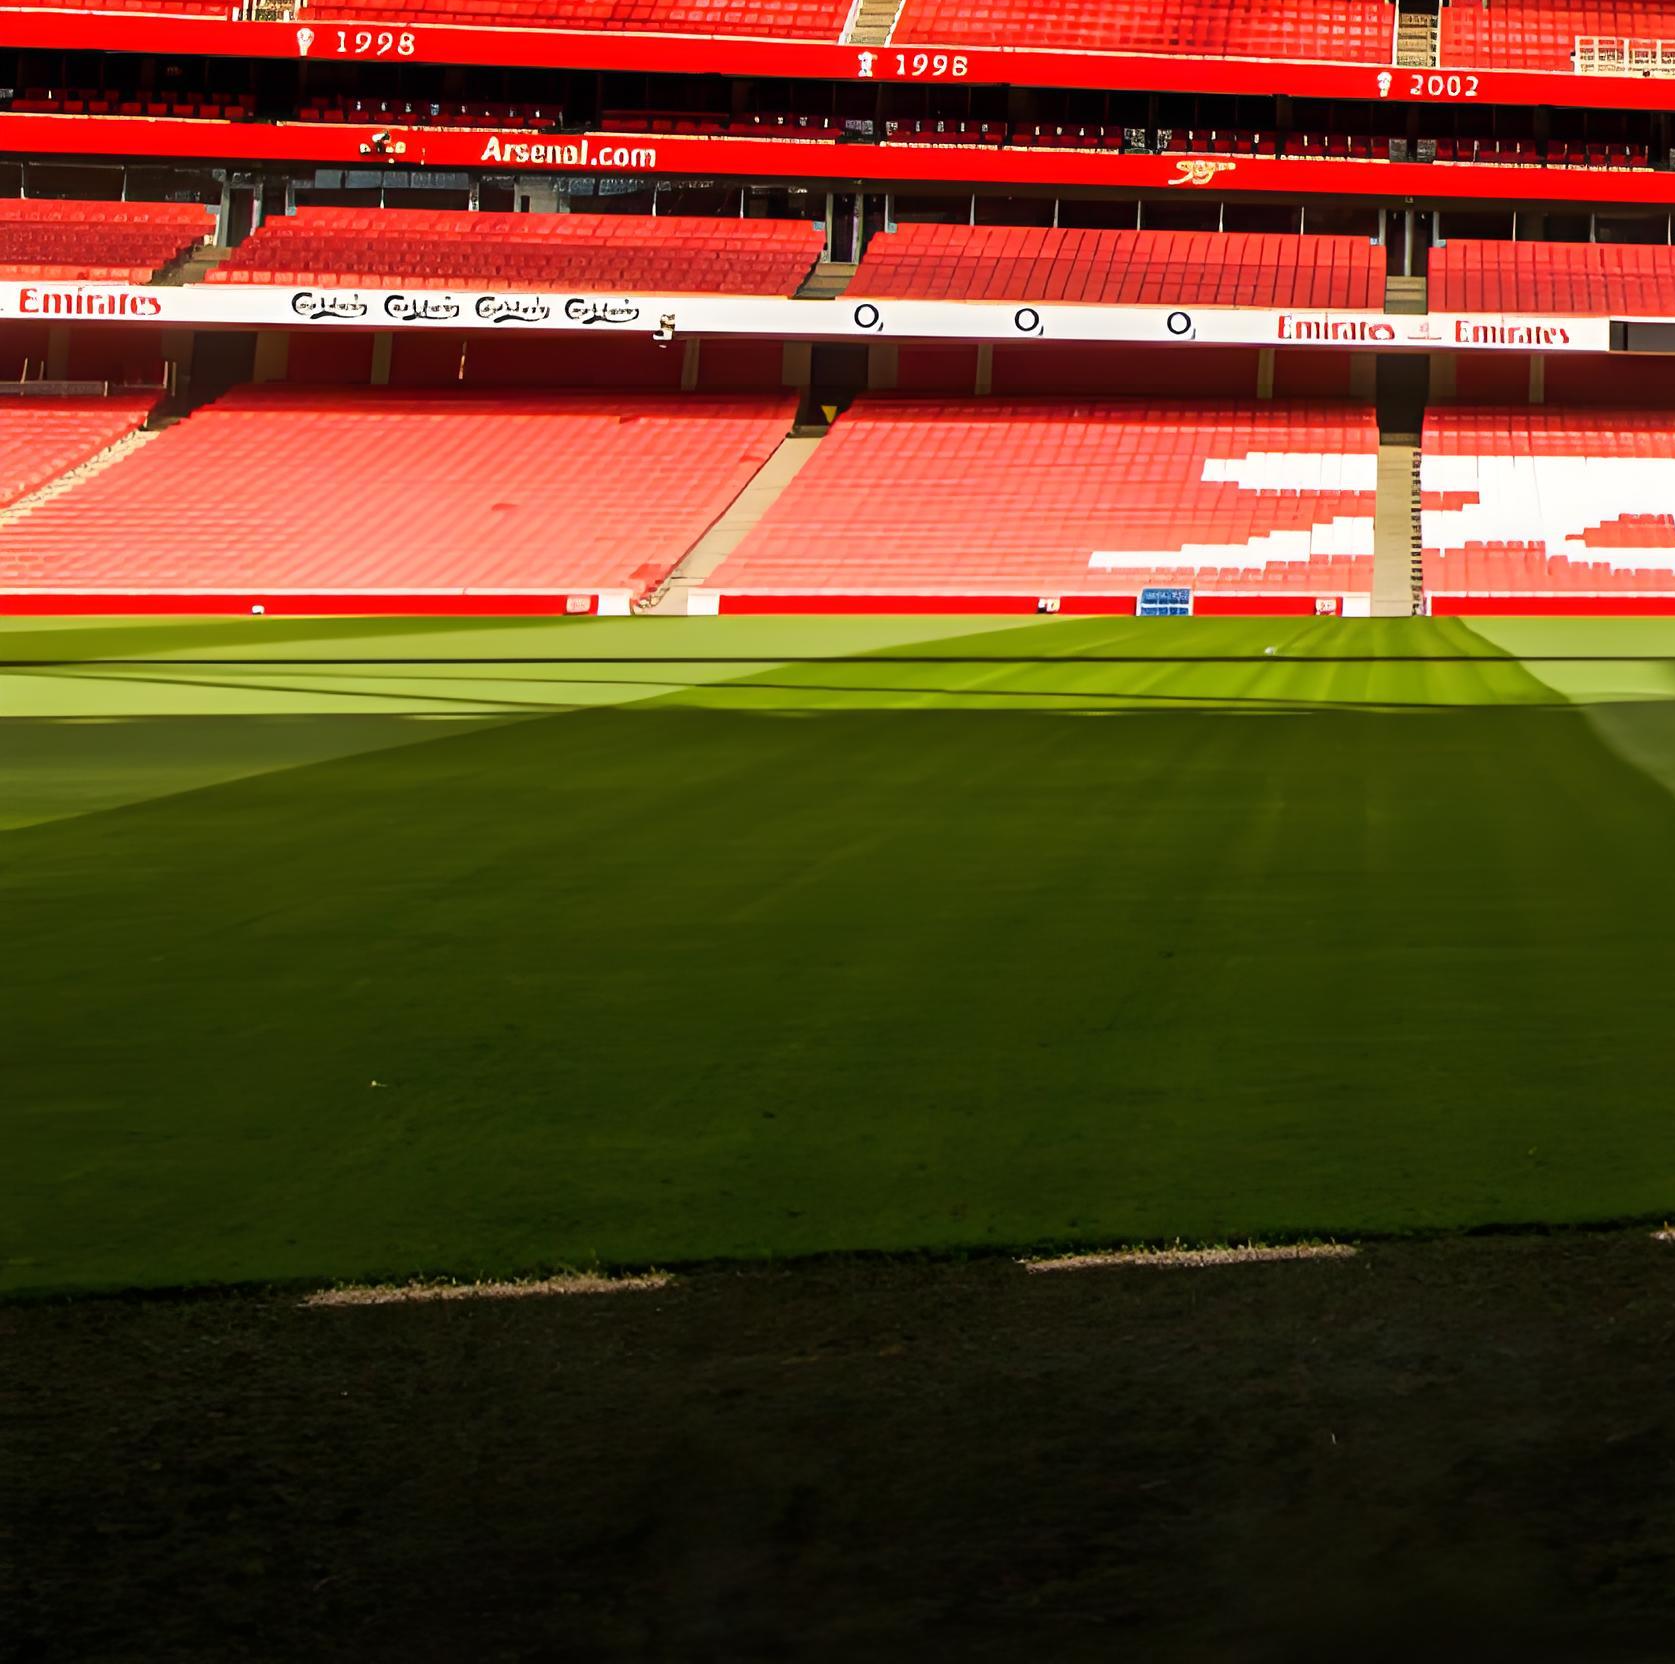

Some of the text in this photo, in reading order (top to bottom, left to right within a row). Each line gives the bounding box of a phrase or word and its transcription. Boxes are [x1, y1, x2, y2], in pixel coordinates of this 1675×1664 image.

[336, 30, 416, 56] 1998
[1409, 74, 1479, 97] 2002
[480, 135, 657, 168] Arsenal.com
[19, 287, 162, 316] Emirates
